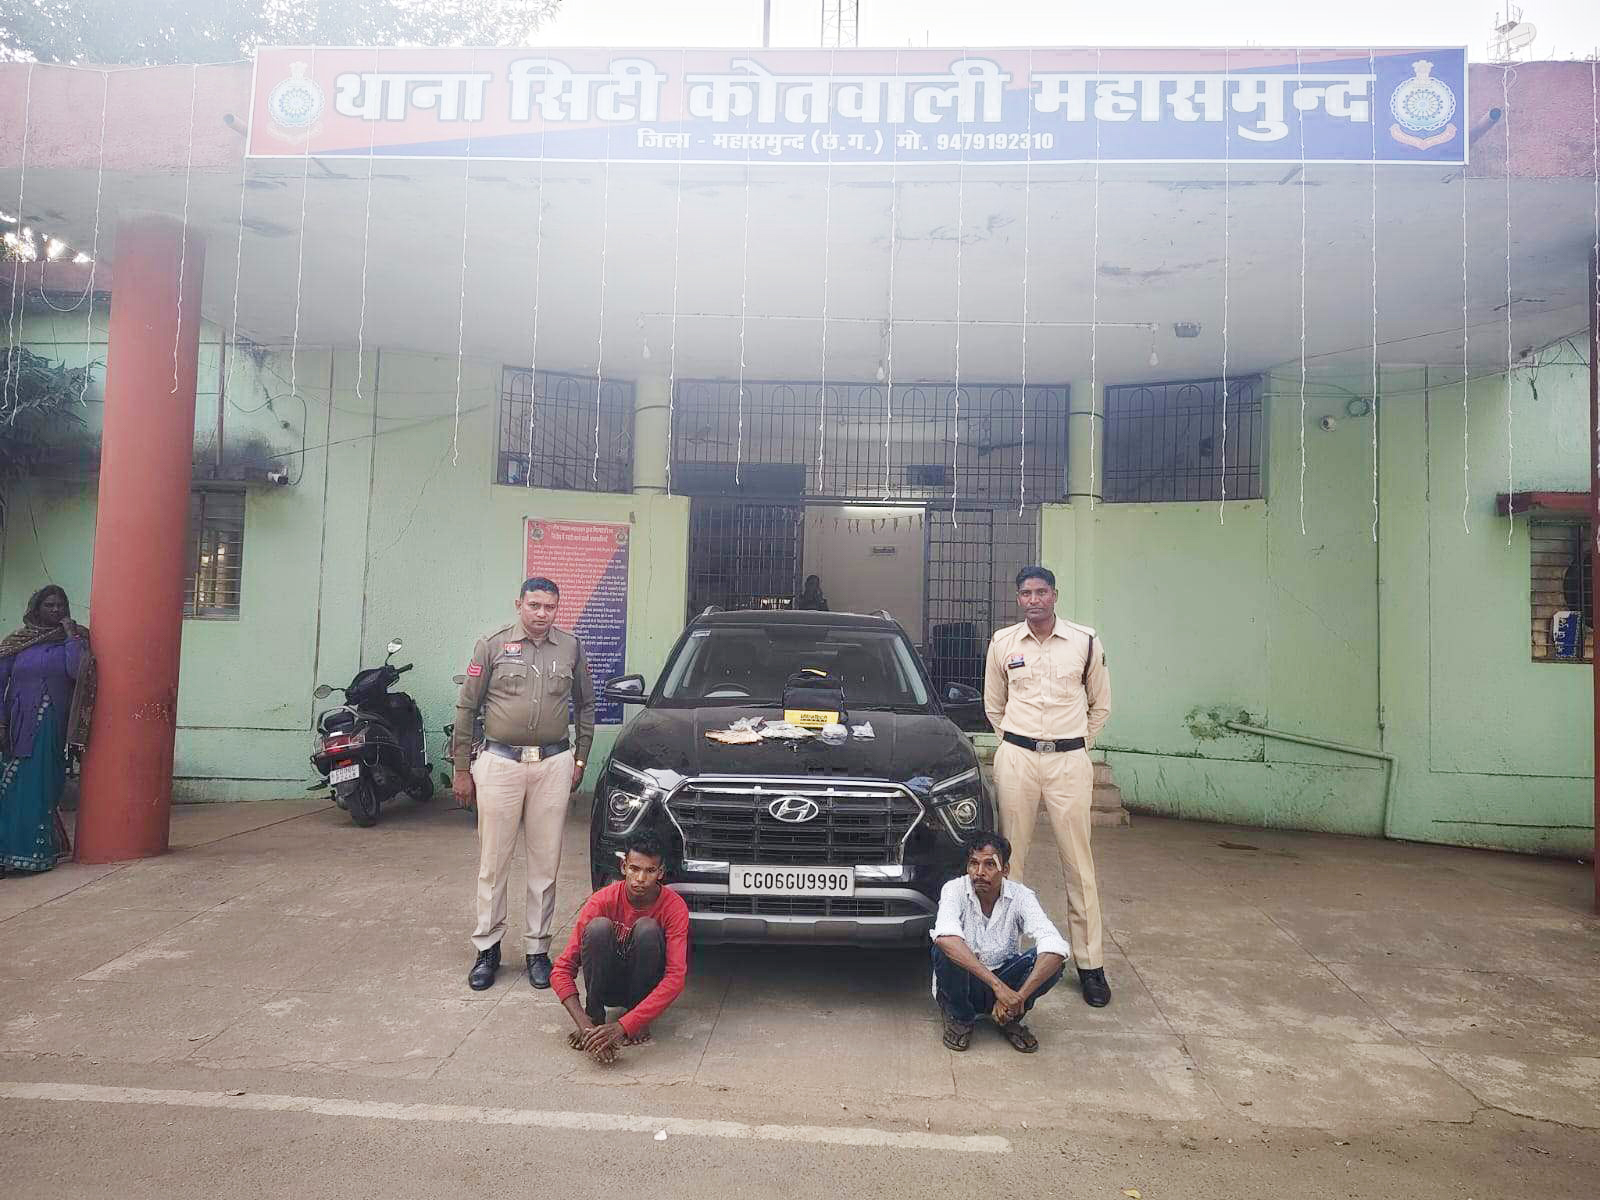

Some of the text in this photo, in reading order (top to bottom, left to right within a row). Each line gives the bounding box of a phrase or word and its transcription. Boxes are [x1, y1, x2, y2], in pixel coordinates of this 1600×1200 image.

[335, 58, 1377, 141] थाना सिटी कोतवाली महासमुन्द
[637, 128, 691, 149] जिला
[712, 134, 806, 156] महासमुन्द
[896, 130, 928, 151] मो.
[937, 132, 1054, 151] 9479192310
[743, 872, 848, 891] CG06GU9990
